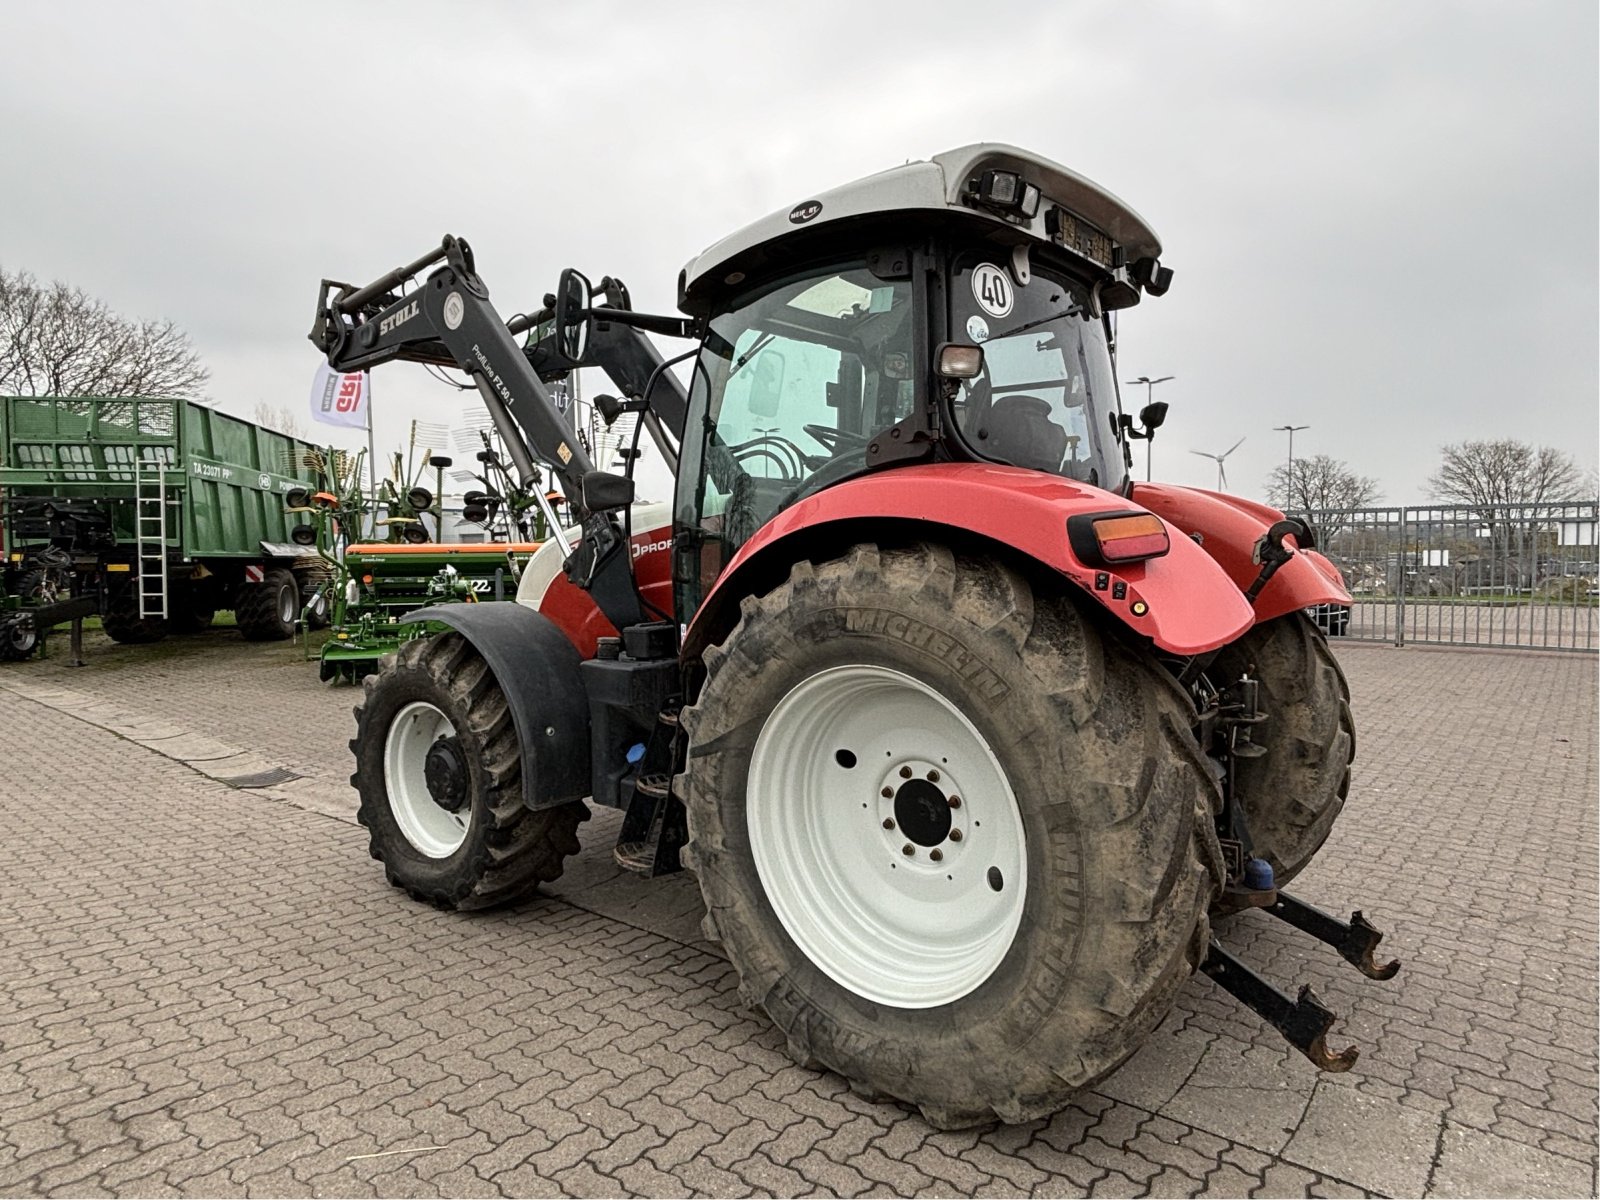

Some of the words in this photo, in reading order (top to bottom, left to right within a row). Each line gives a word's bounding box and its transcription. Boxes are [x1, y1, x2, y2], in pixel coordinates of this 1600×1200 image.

[982, 272, 1006, 308] 40
[380, 300, 419, 336] STOLL
[472, 344, 495, 378] ProfiLine
[493, 375, 504, 390] FZ
[501, 386, 514, 406] 50.1
[193, 462, 203, 475] TA
[641, 540, 672, 555] PROF
[846, 608, 1004, 700] MICHELIN
